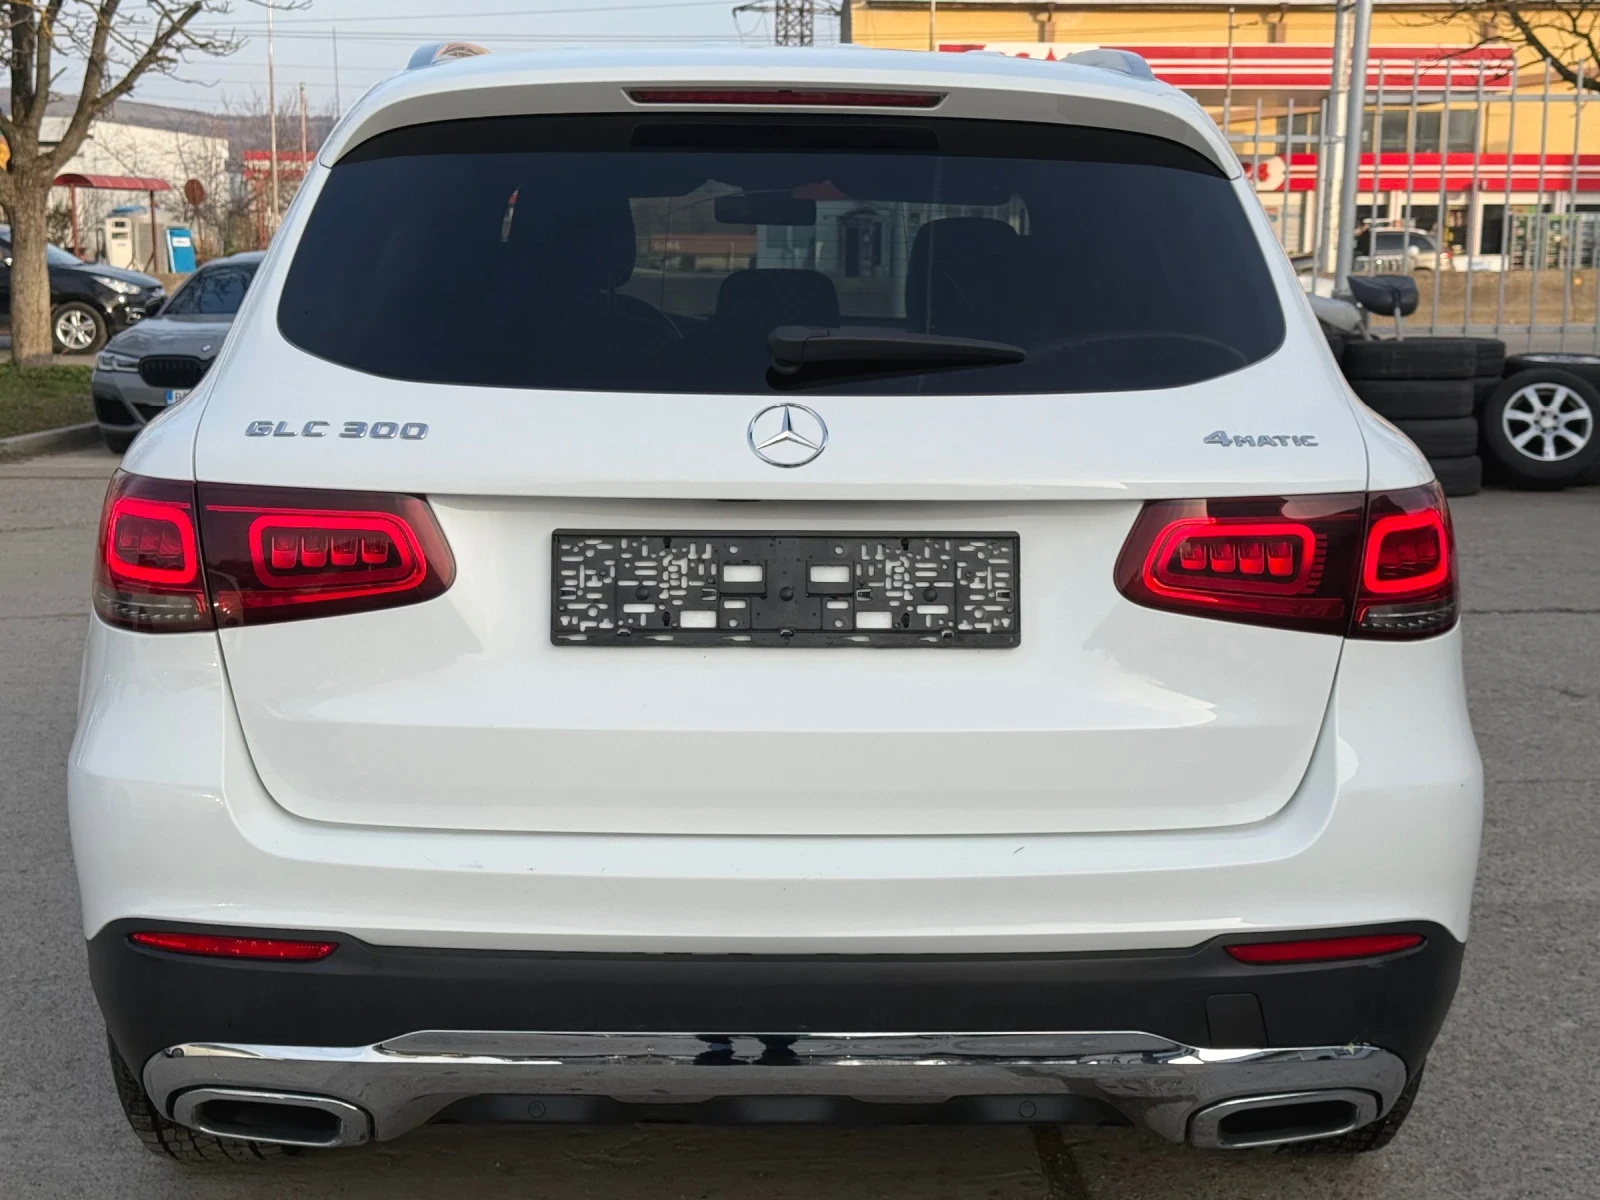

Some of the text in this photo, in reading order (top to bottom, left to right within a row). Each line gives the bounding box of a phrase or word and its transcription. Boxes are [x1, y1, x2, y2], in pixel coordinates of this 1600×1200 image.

[245, 420, 430, 440] GLC 300
[1203, 430, 1319, 447] 4MATIC
